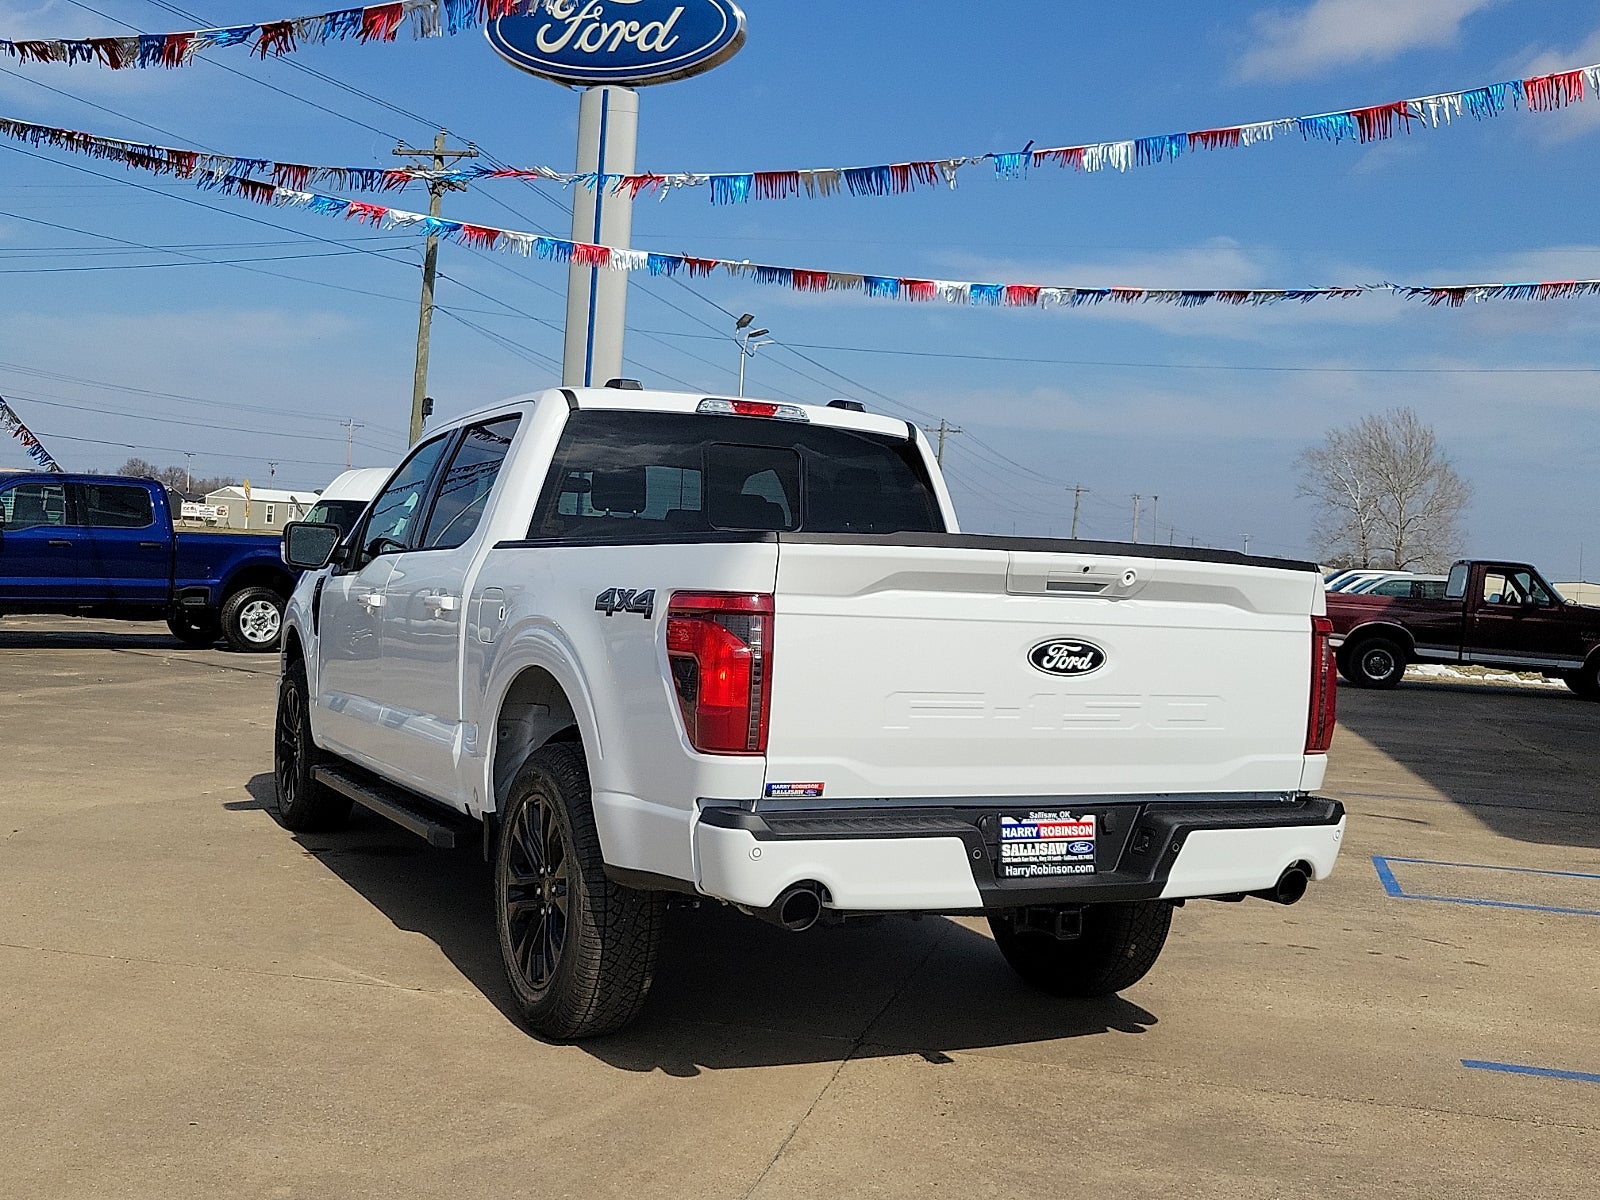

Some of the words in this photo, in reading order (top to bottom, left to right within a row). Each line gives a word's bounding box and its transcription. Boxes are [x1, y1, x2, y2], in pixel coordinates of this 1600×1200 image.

[536, 0, 685, 53] Ford
[1042, 643, 1094, 670] Ford
[1059, 811, 1071, 819] OK
[1002, 826, 1038, 838] HARRY
[1040, 825, 1093, 837] ROBINSON
[1002, 843, 1068, 856] SALLISAW
[1072, 842, 1090, 852] Ford
[1005, 864, 1094, 877] HarryRobinson.com
